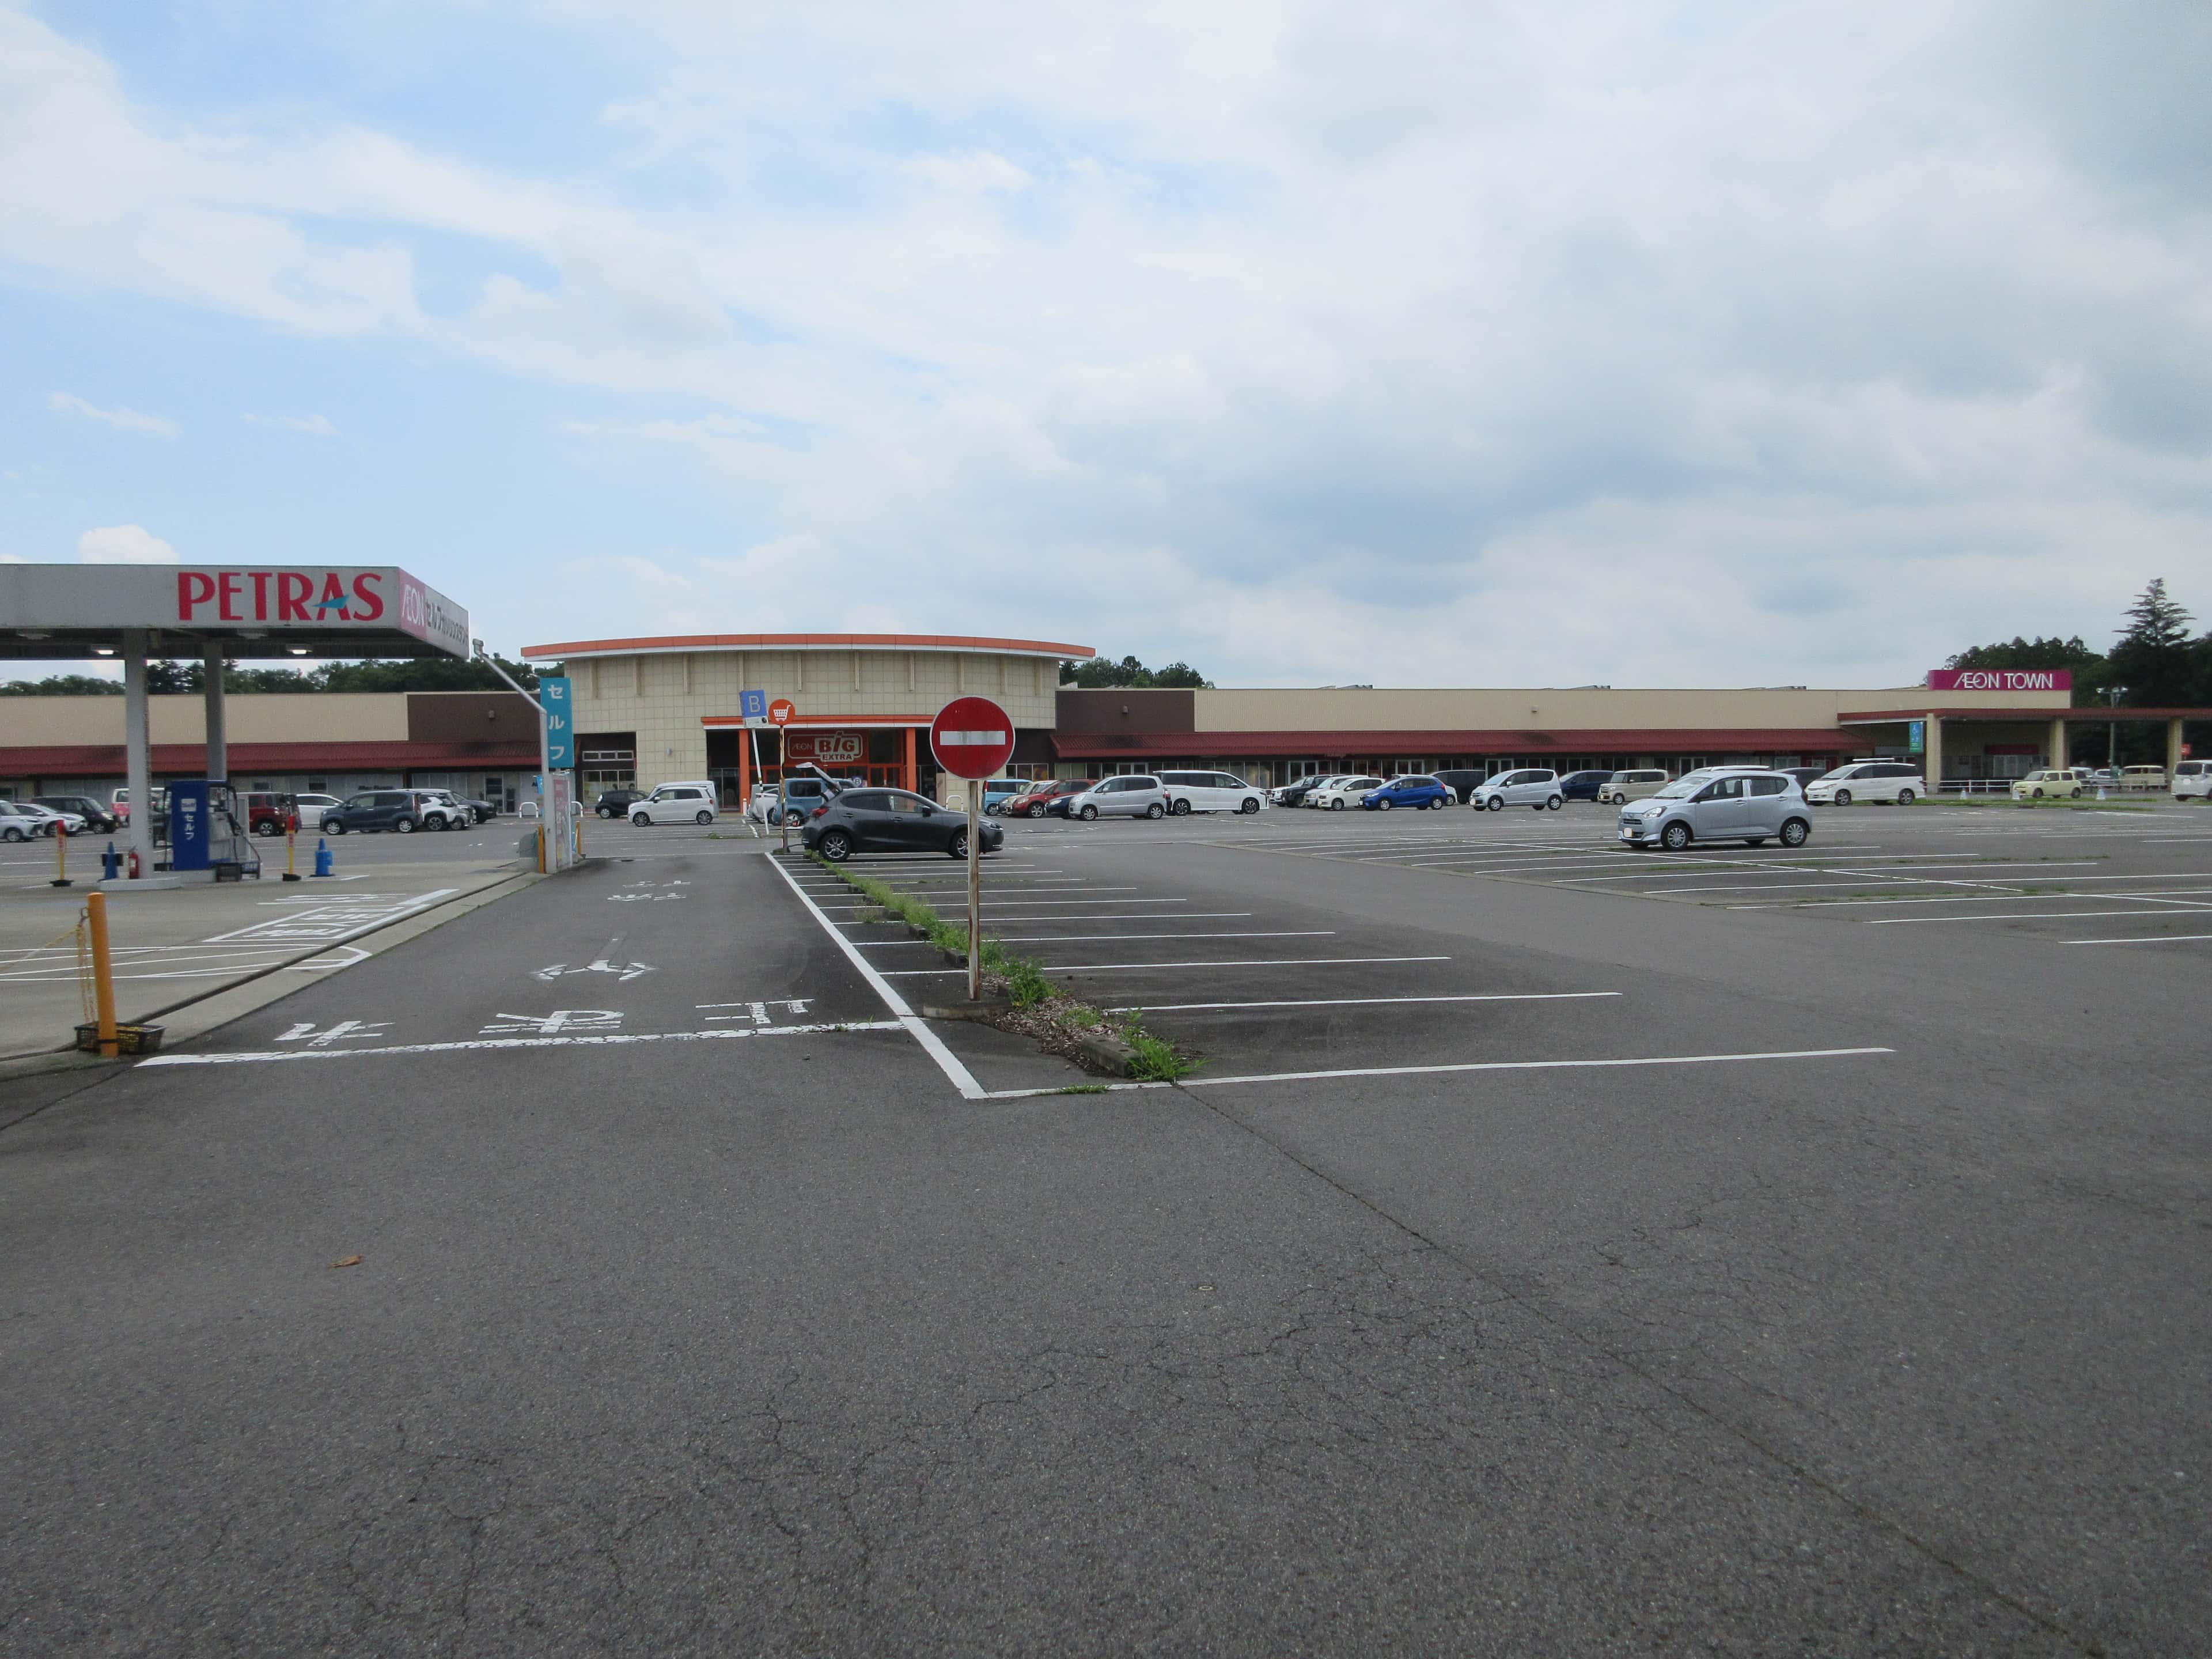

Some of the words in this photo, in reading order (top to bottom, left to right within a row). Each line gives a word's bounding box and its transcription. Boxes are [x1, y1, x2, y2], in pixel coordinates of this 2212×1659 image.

[178, 572, 384, 621] PETRAS
[2004, 673, 2052, 689] TOWN
[547, 684, 565, 760] セルフ
[748, 695, 760, 713] B
[184, 814, 195, 840] セルフ
[274, 998, 815, 1047] 止まれ
